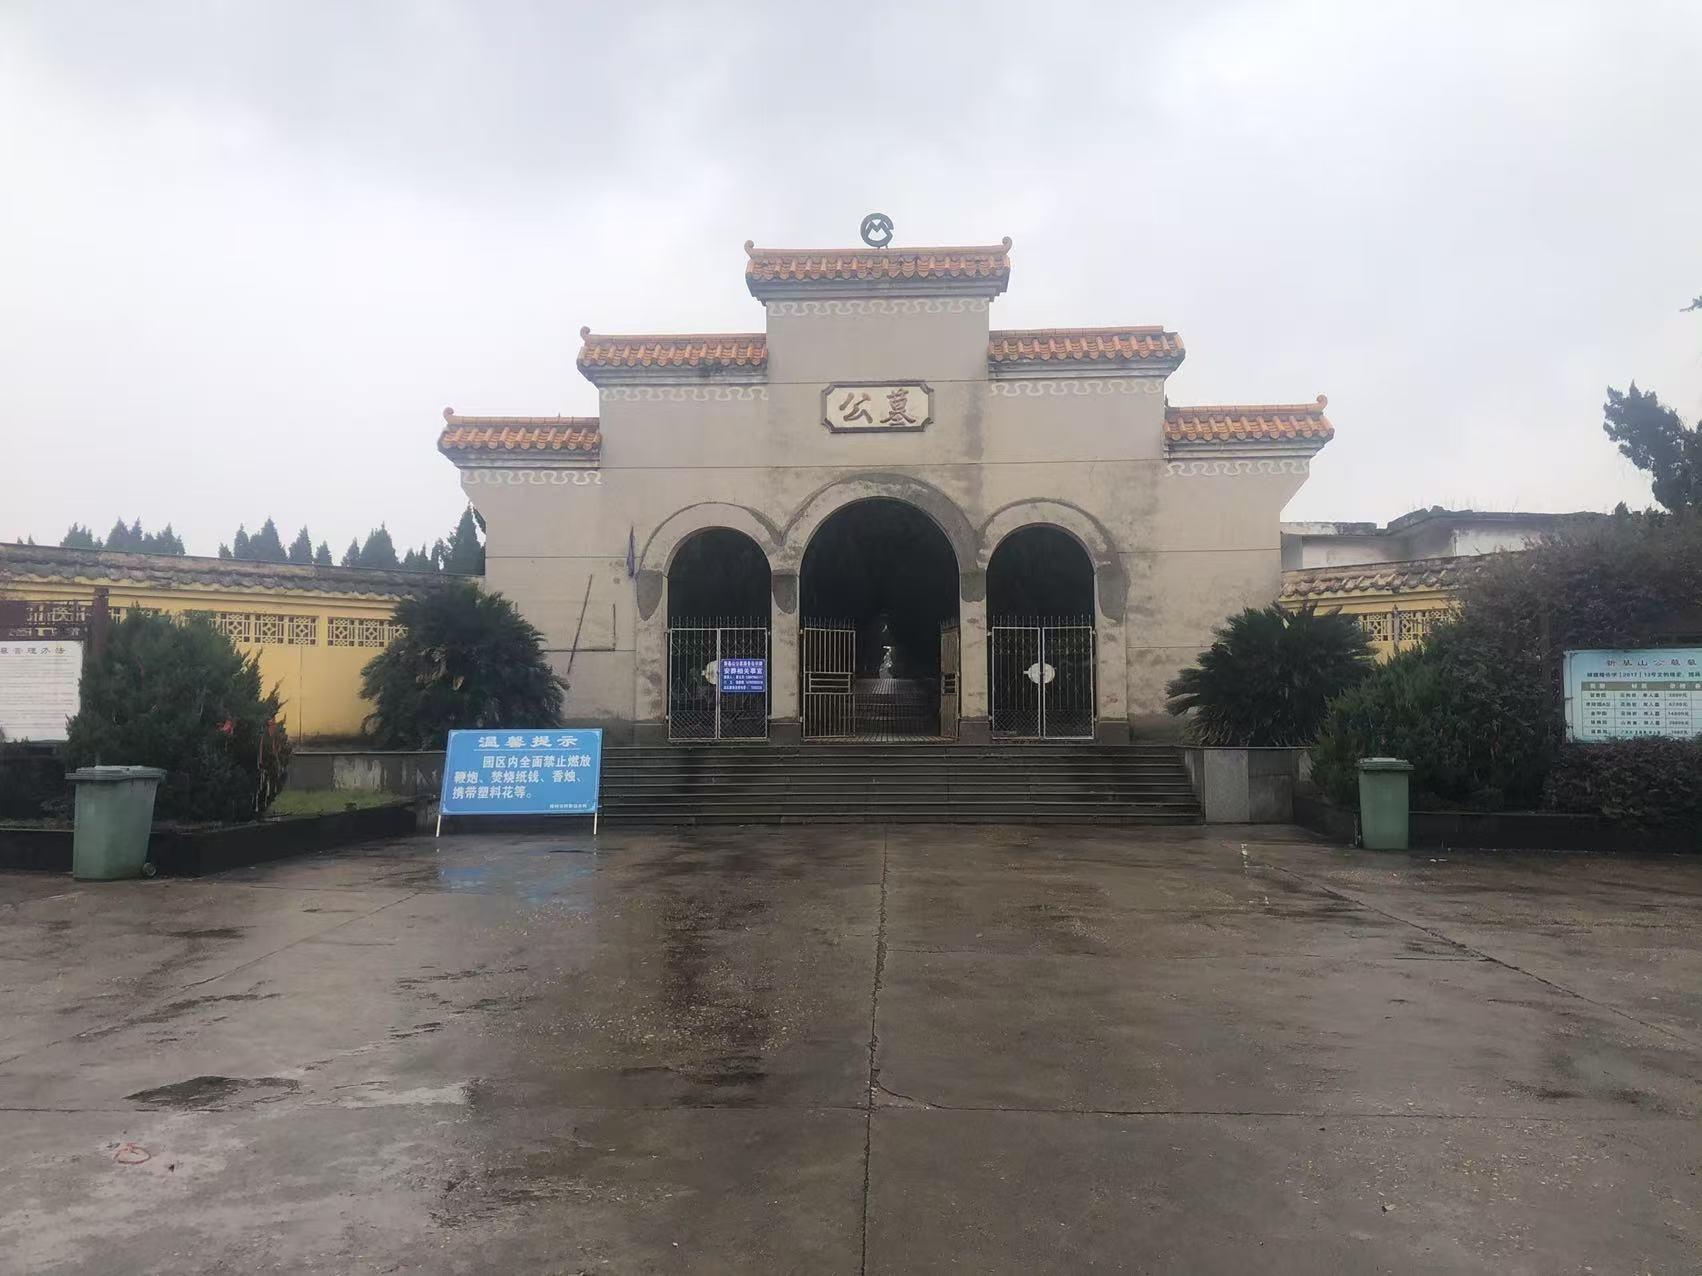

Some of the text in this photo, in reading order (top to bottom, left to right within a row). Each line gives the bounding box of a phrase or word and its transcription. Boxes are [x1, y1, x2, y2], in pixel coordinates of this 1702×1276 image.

[838, 388, 917, 427] 公墓
[478, 735, 579, 749] 温馨提示
[482, 755, 592, 769] 园区内全面禁止燃放
[452, 785, 533, 800] 携带塑料花等。
